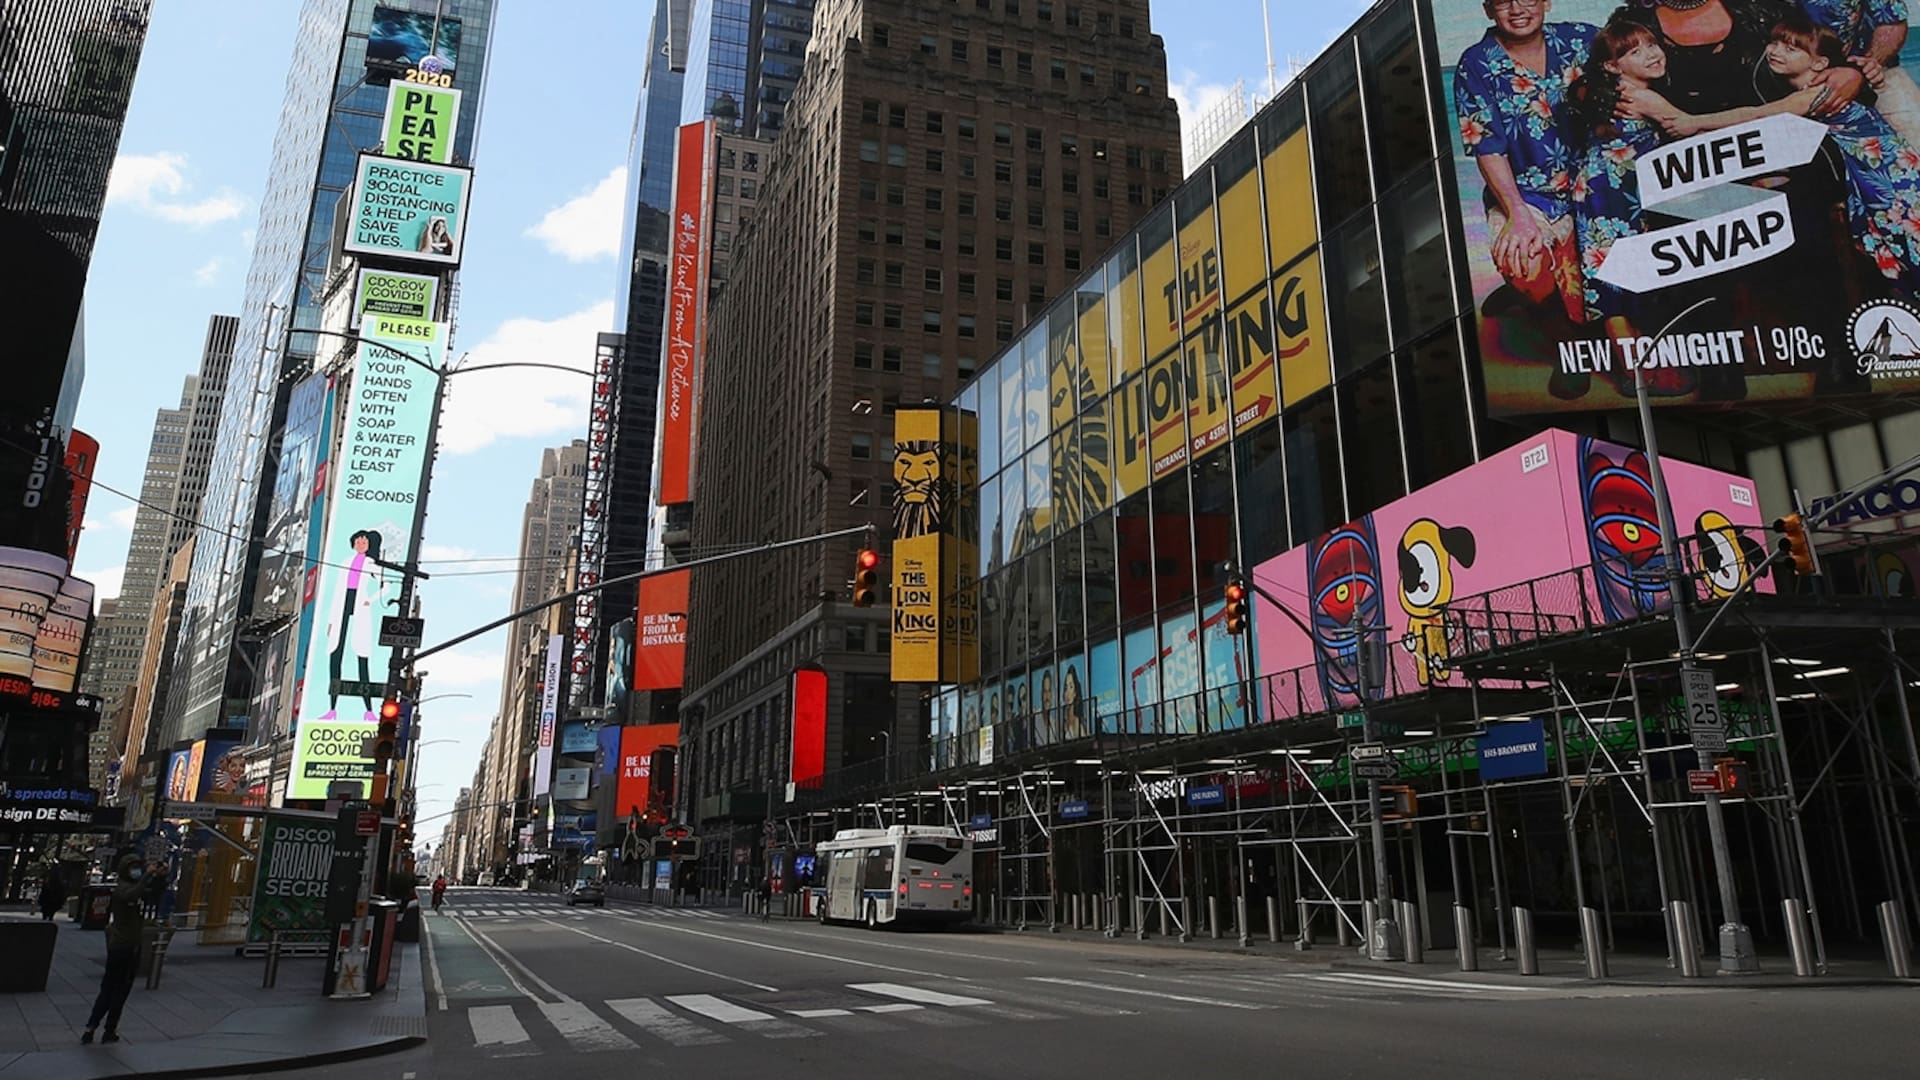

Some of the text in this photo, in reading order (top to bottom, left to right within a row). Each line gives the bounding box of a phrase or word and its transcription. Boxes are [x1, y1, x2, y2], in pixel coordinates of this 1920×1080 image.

[406, 68, 452, 88] 2020
[404, 91, 438, 115] PL
[400, 116, 436, 139] EA
[396, 139, 434, 163] SE
[1652, 130, 1766, 190] WIFE
[369, 166, 445, 187] PRACTICE
[366, 180, 422, 196] SOCIAL
[364, 192, 456, 214] DISTANCING
[362, 205, 416, 222] & HELP
[359, 218, 400, 233] SAVE
[358, 231, 403, 248] LIVES.
[1651, 210, 1784, 277] SWAP
[368, 276, 426, 291] CDC.GOV
[1163, 247, 1219, 323] THE
[366, 286, 425, 302] /COVID19
[380, 322, 431, 337] PLEASE
[368, 348, 411, 362] WASH
[1558, 338, 1612, 374] NEW
[1616, 330, 1745, 370] TONIGHT
[1771, 325, 1826, 367] 9/8c
[366, 362, 406, 375] YOUR
[1120, 277, 1309, 466] LION KING
[363, 375, 413, 390] HANDS
[361, 388, 408, 403] OFTEN
[360, 403, 395, 416] WITH
[357, 417, 396, 429] SOAP
[355, 431, 416, 446] & WATER
[1154, 405, 1259, 474] ENTRANCE ON 45TH STREET
[353, 445, 403, 460] FOR AT
[1524, 449, 1546, 468] BT21
[351, 459, 395, 473] LEAST
[348, 474, 365, 485] 20
[345, 488, 415, 504] SECONDS
[1731, 487, 1751, 503] BT21
[901, 572, 925, 583] THE
[897, 587, 931, 607] LION
[643, 614, 655, 625] BE
[894, 609, 936, 633] KING
[643, 624, 677, 635] FROM A
[642, 633, 686, 646] DISTANCE
[547, 662, 557, 692] VISION
[1692, 703, 1718, 725] 25
[626, 756, 637, 767] BE
[624, 766, 650, 778] A DIS
[14, 787, 68, 802] spreads
[4, 807, 32, 823] sign
[36, 808, 58, 820] DE
[975, 829, 998, 842] TISSOT
[269, 841, 335, 881] BROADW
